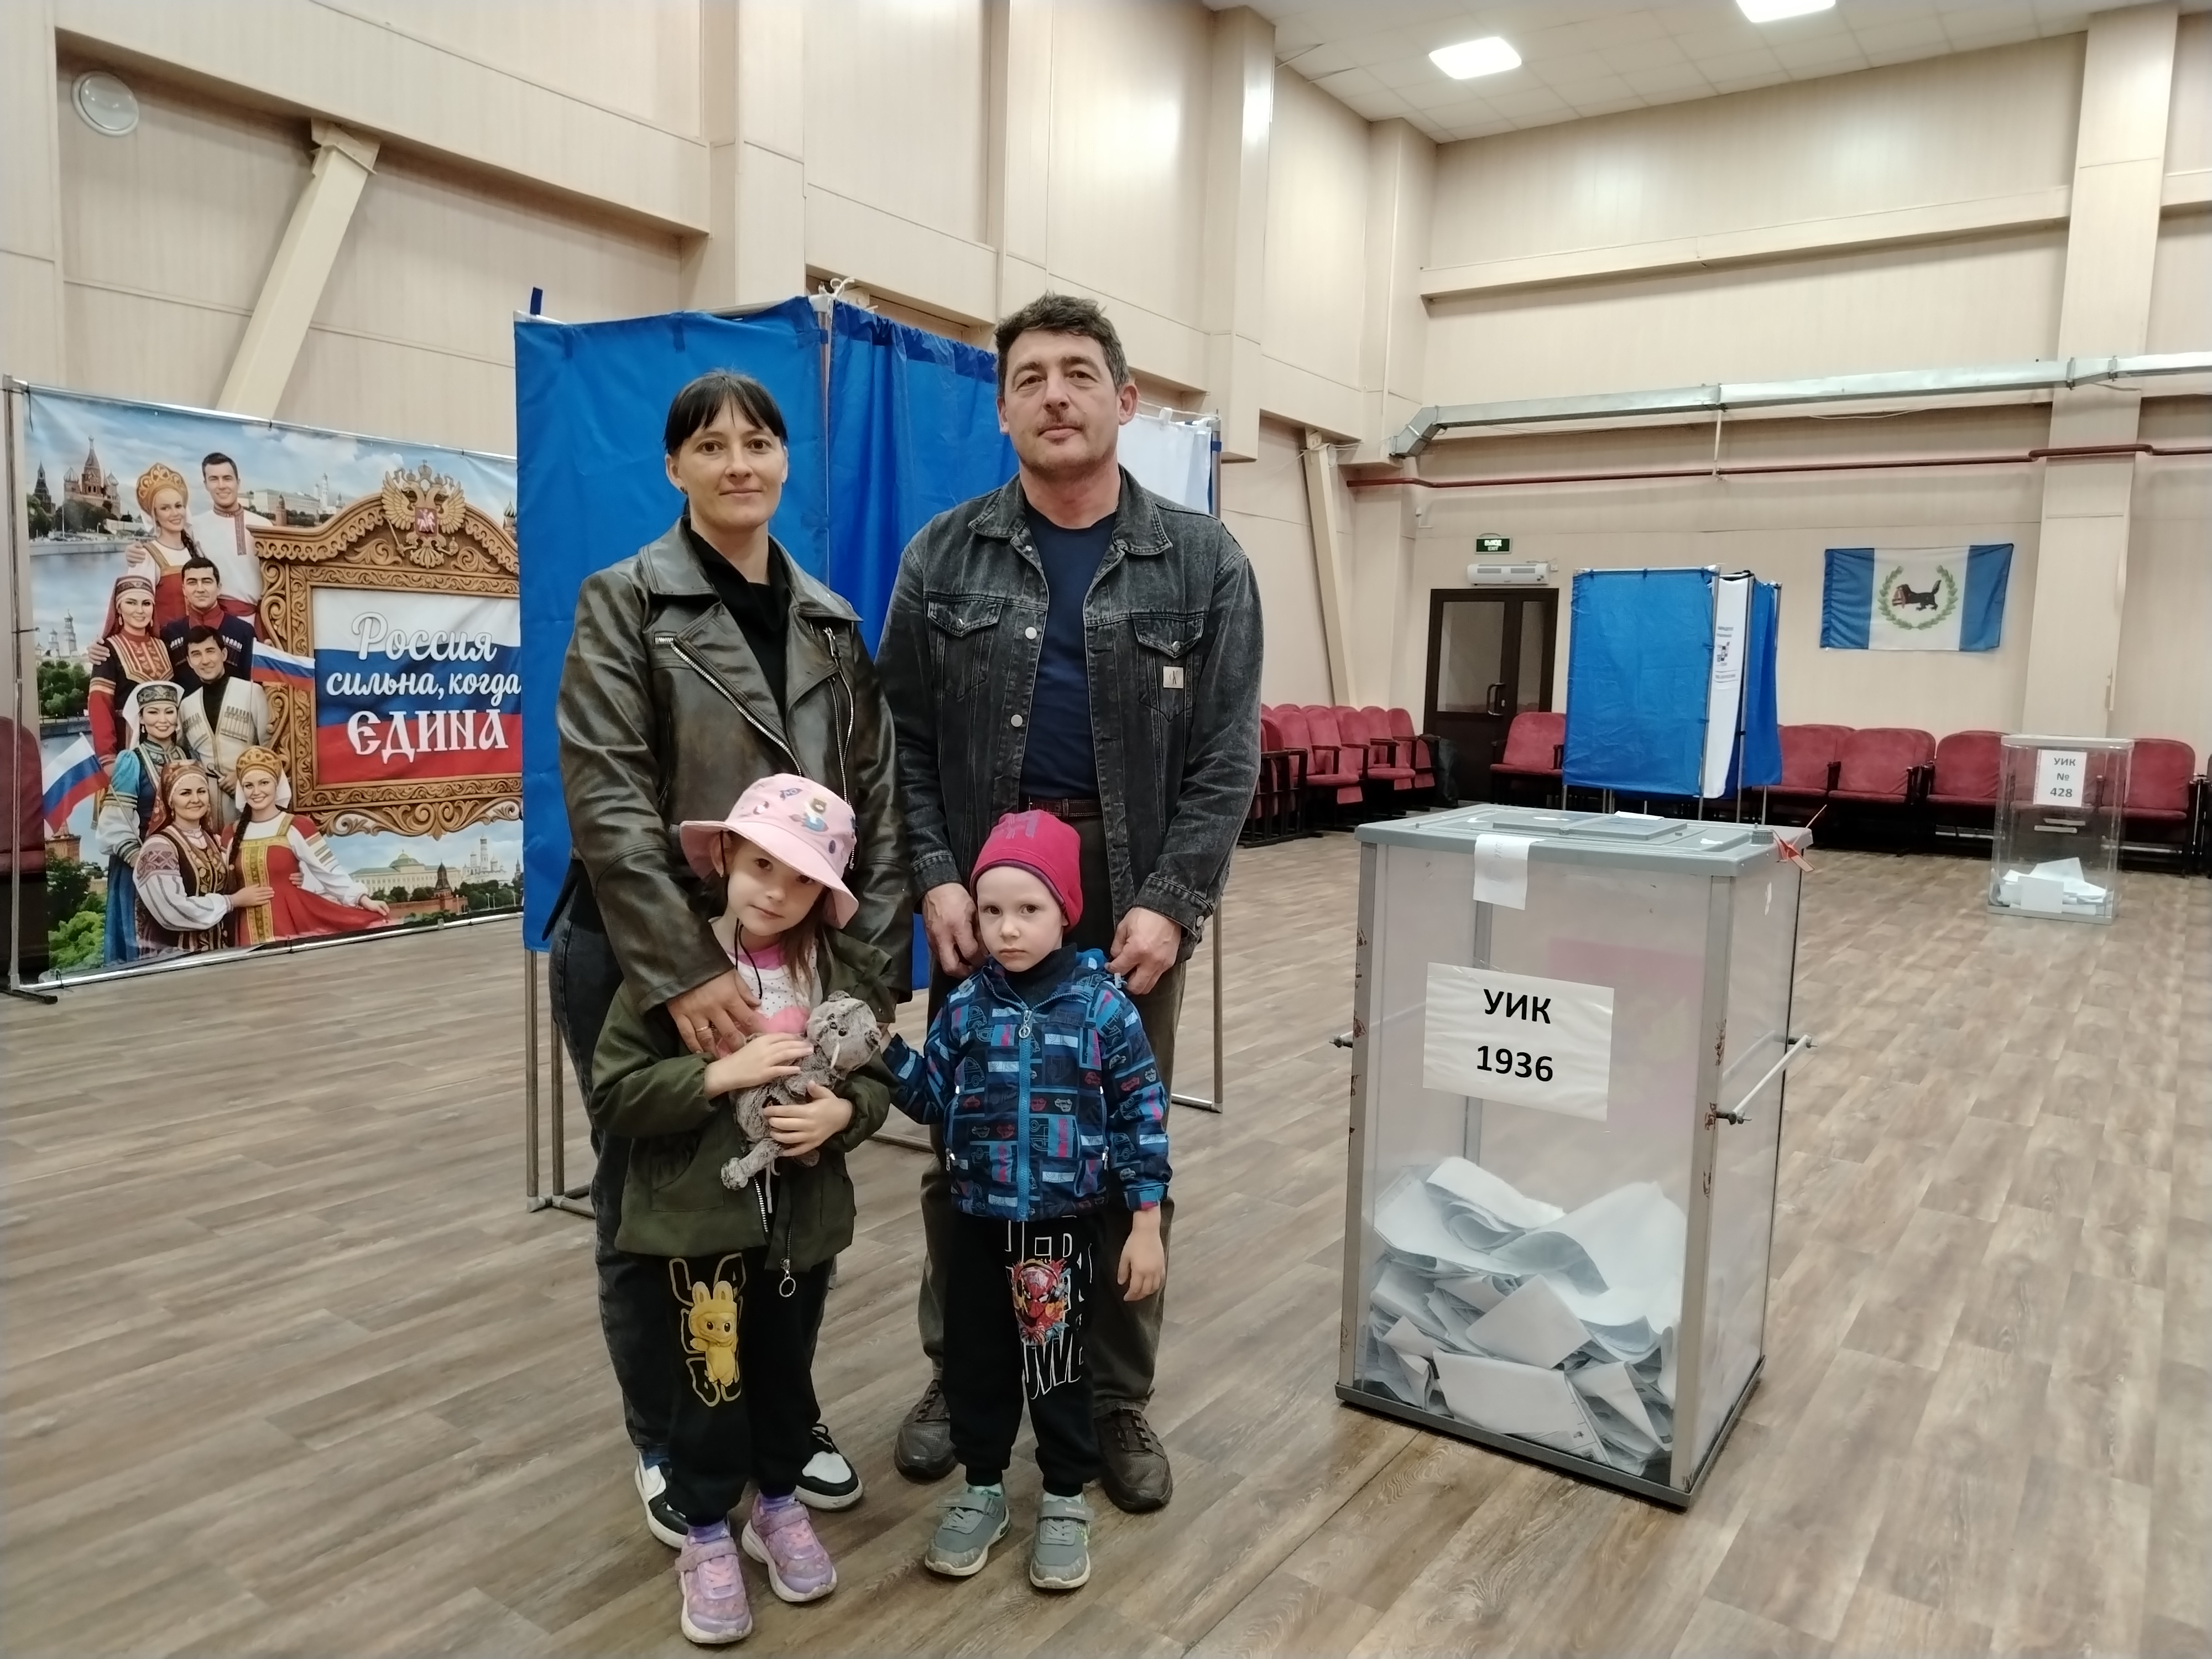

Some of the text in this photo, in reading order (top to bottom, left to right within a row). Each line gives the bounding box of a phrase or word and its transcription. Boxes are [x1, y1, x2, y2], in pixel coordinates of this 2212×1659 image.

[352, 612, 498, 661] Россия
[326, 671, 521, 707] сильна, когда
[347, 708, 509, 764] ЕДИНА
[2053, 757, 2076, 766] УИК
[2057, 773, 2070, 781] №
[2049, 787, 2073, 797] 428
[1483, 989, 1551, 1024] УИК
[1477, 1045, 1553, 1082] 1936
